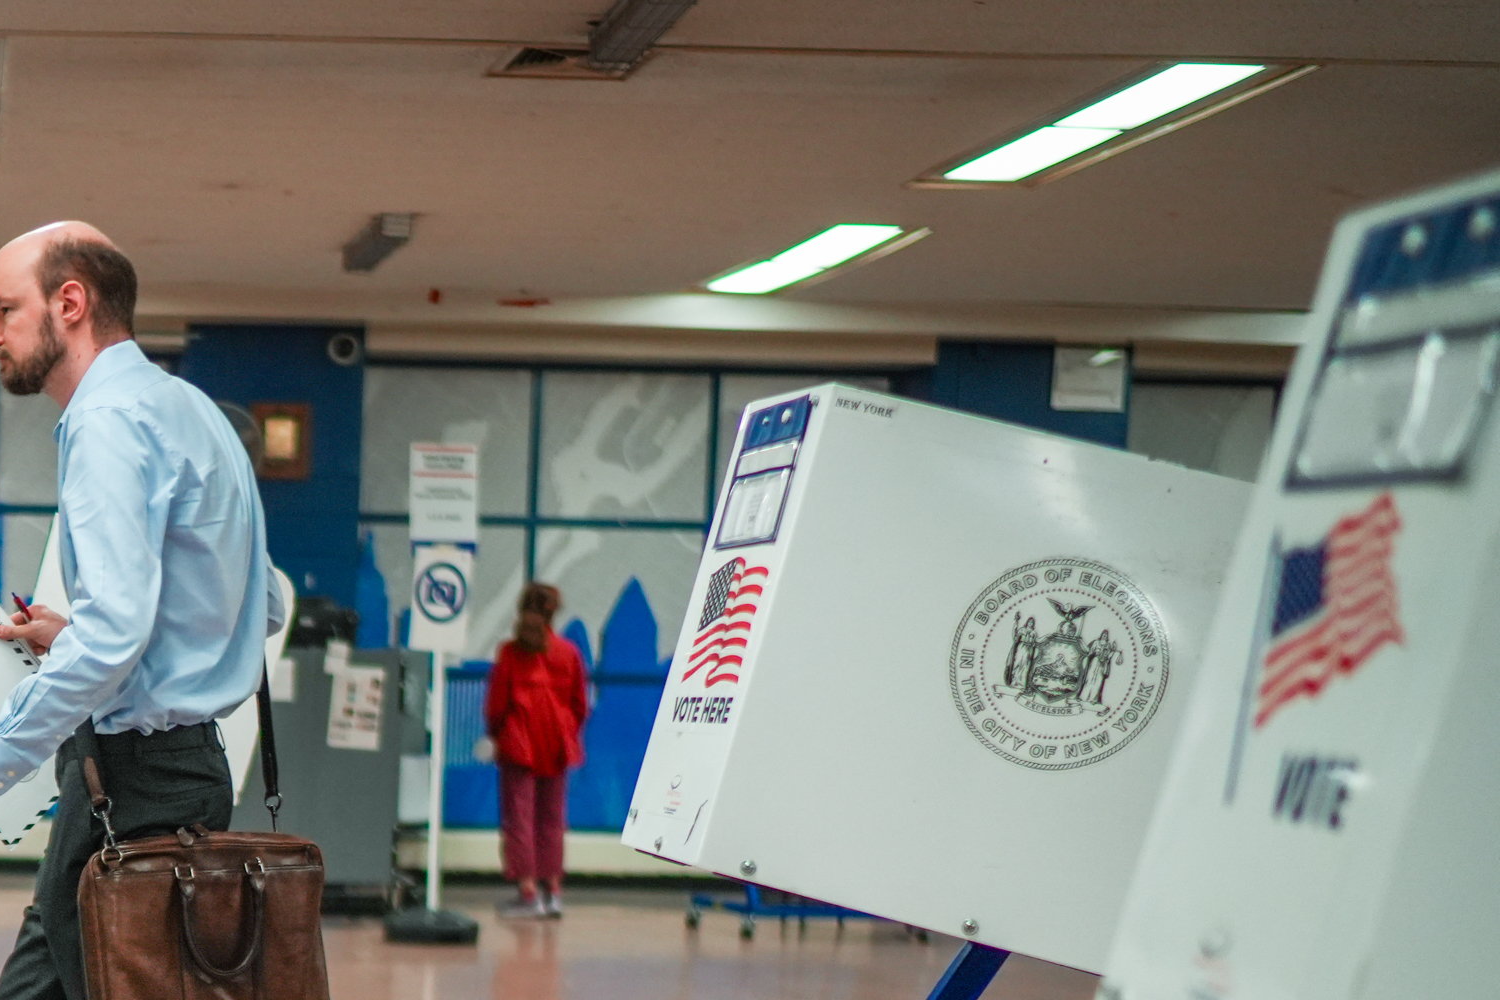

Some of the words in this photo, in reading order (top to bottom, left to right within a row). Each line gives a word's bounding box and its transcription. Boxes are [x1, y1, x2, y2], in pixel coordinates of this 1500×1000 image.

[835, 398, 861, 410] NEW
[863, 403, 894, 418] YORK
[974, 574, 1038, 626] BOARD
[1044, 568, 1072, 583] OF
[1078, 571, 1158, 658] ELECTIONS
[959, 648, 975, 669] IN
[961, 675, 985, 716] THE
[1024, 700, 1073, 715] EXCELSIOR
[1111, 682, 1155, 733] YORK
[672, 696, 703, 723] VOTE
[699, 696, 734, 724] HERE
[981, 717, 1026, 751] CITY
[1063, 732, 1111, 759] NEW
[1029, 743, 1057, 759] OF
